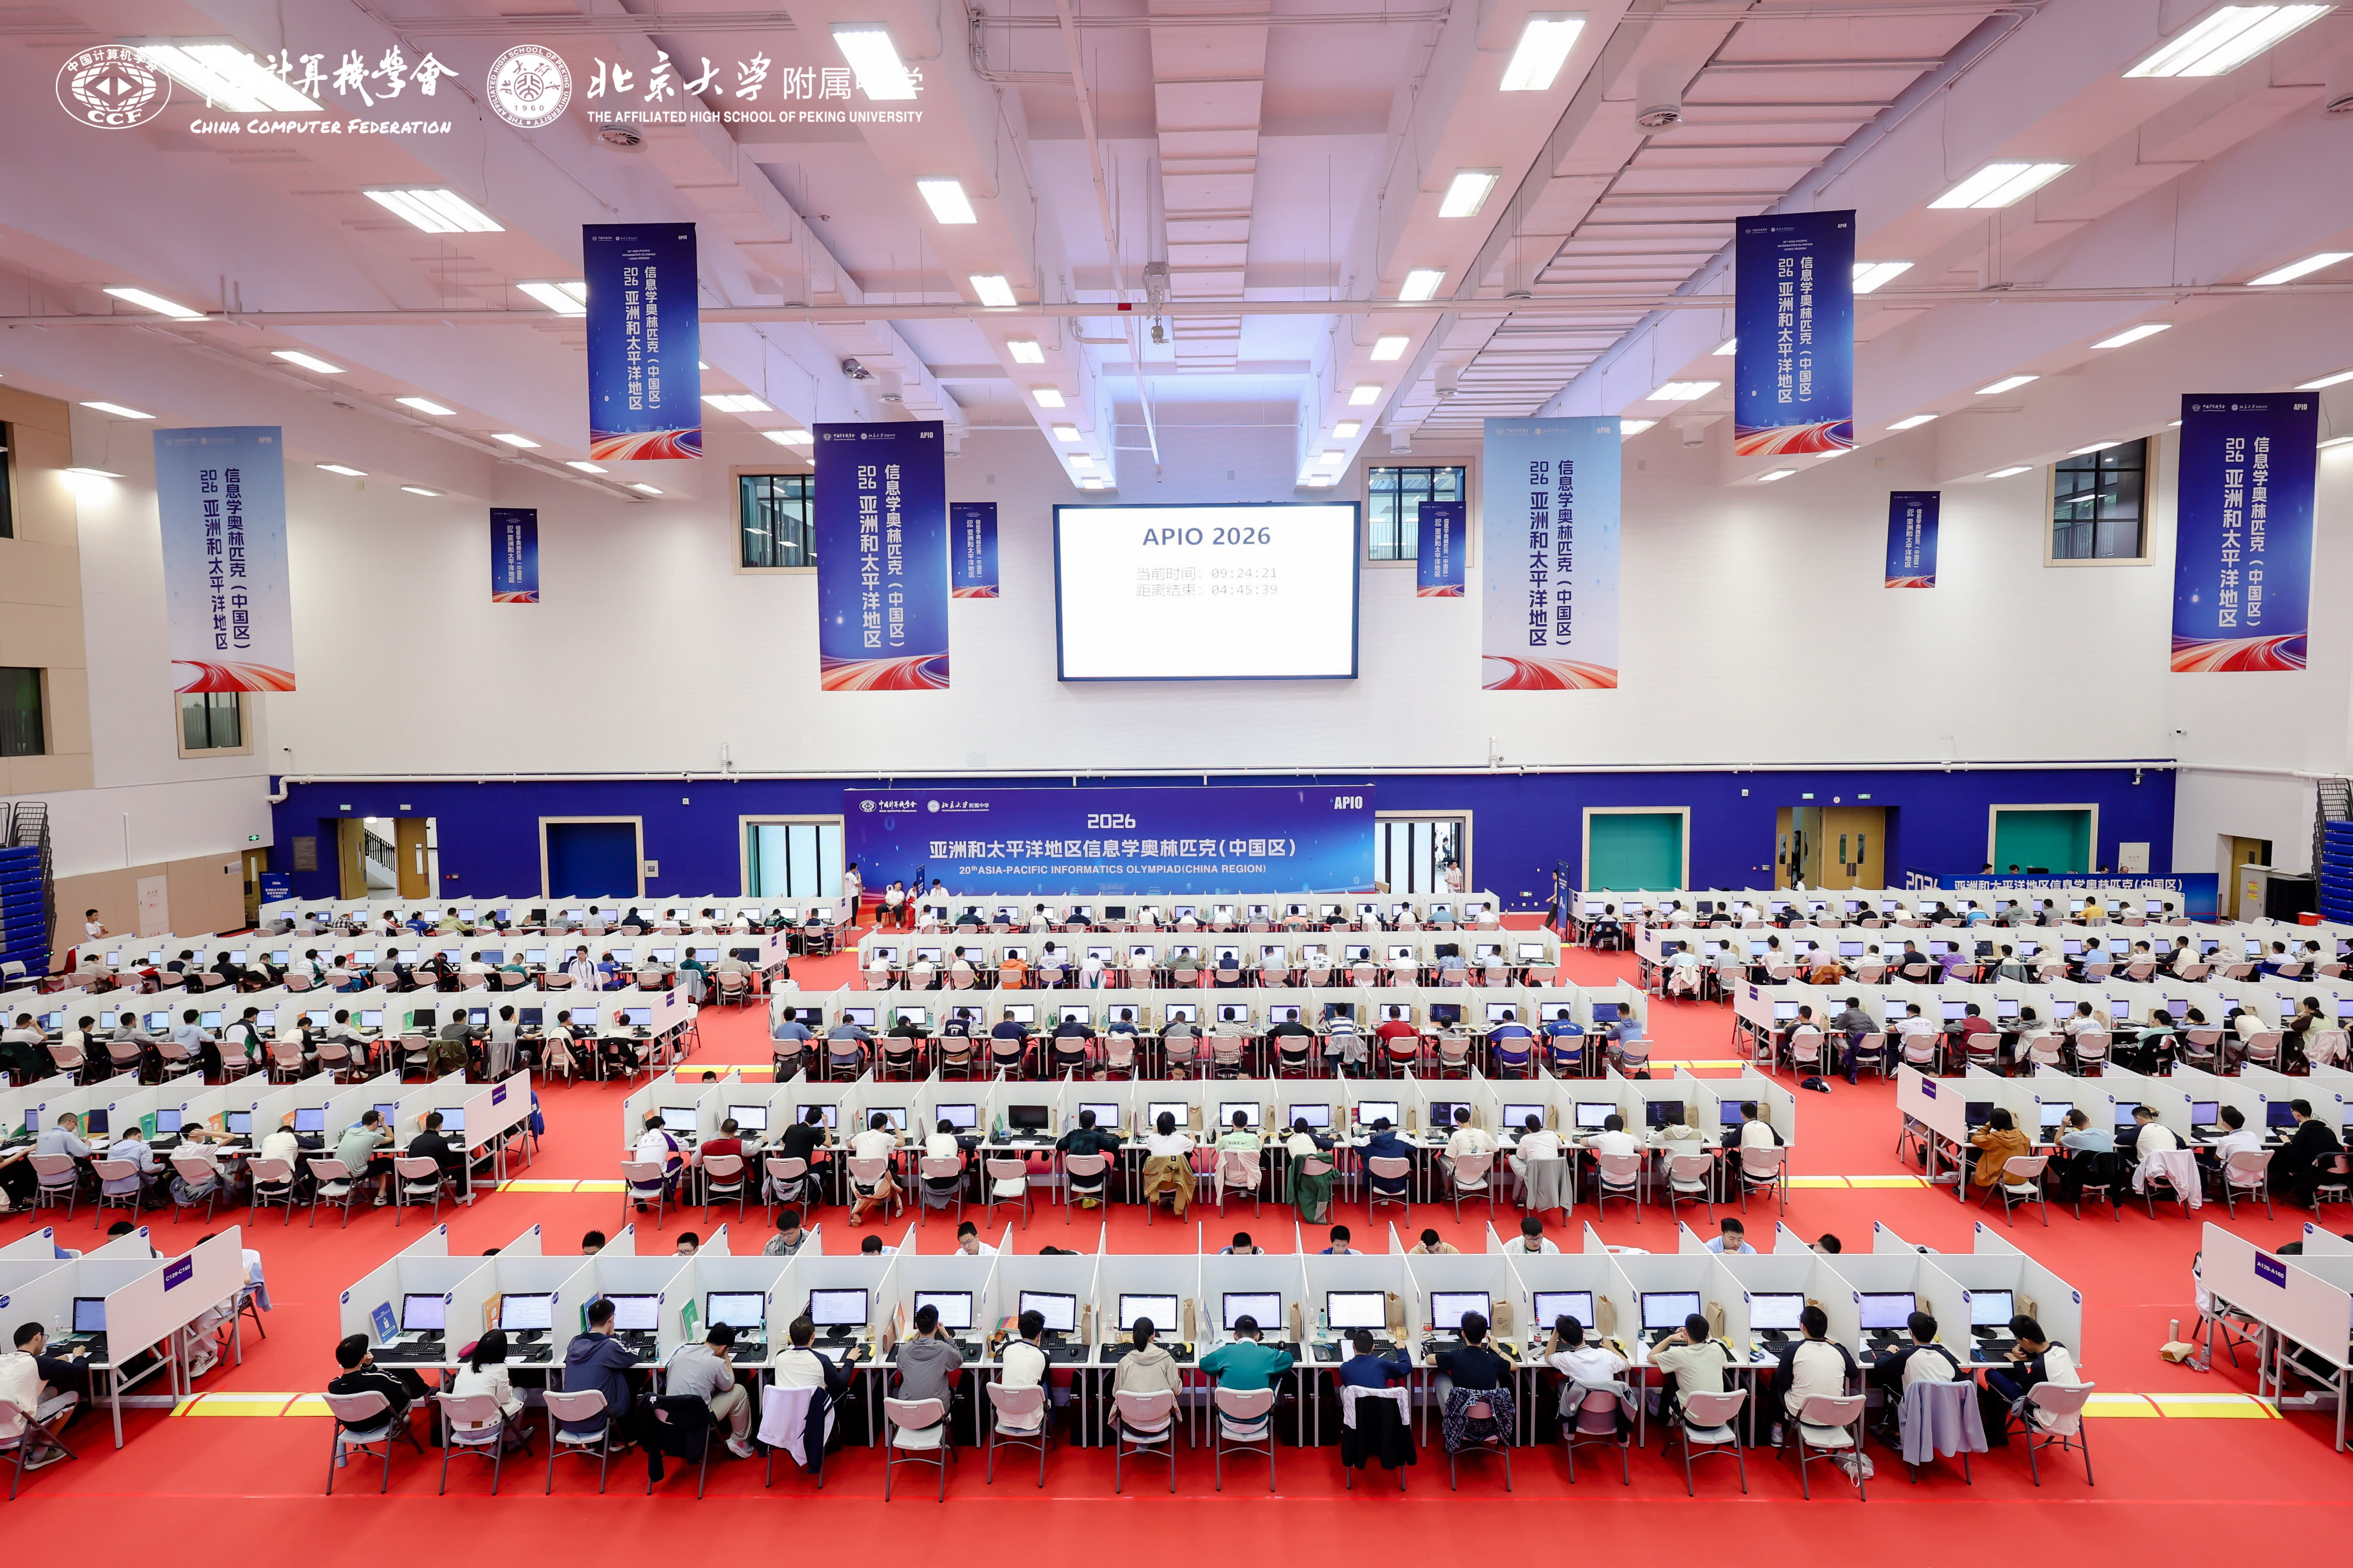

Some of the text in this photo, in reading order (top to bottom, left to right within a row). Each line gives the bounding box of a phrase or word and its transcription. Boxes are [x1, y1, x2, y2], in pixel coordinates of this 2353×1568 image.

[1142, 527, 1271, 545] APIO 2026
[2218, 438, 2245, 627] 2026 亚洲和太平洋地区
[200, 469, 228, 650] 2026 亚洲和太平洋地区
[858, 465, 881, 648] 2026 亚洲和太平洋地区
[1529, 461, 1549, 646] 2026 亚洲和太平洋地区
[1212, 568, 1278, 578] 09:24:21
[1212, 585, 1278, 595] 04:45:39
[1334, 796, 1363, 809] APIO
[1088, 813, 1136, 829] 2026
[1051, 865, 1123, 874] INFORMATICS
[1221, 864, 1267, 873] REGION)
[165, 1265, 191, 1282] C129-C160
[2257, 1261, 2284, 1279] A129-A160
